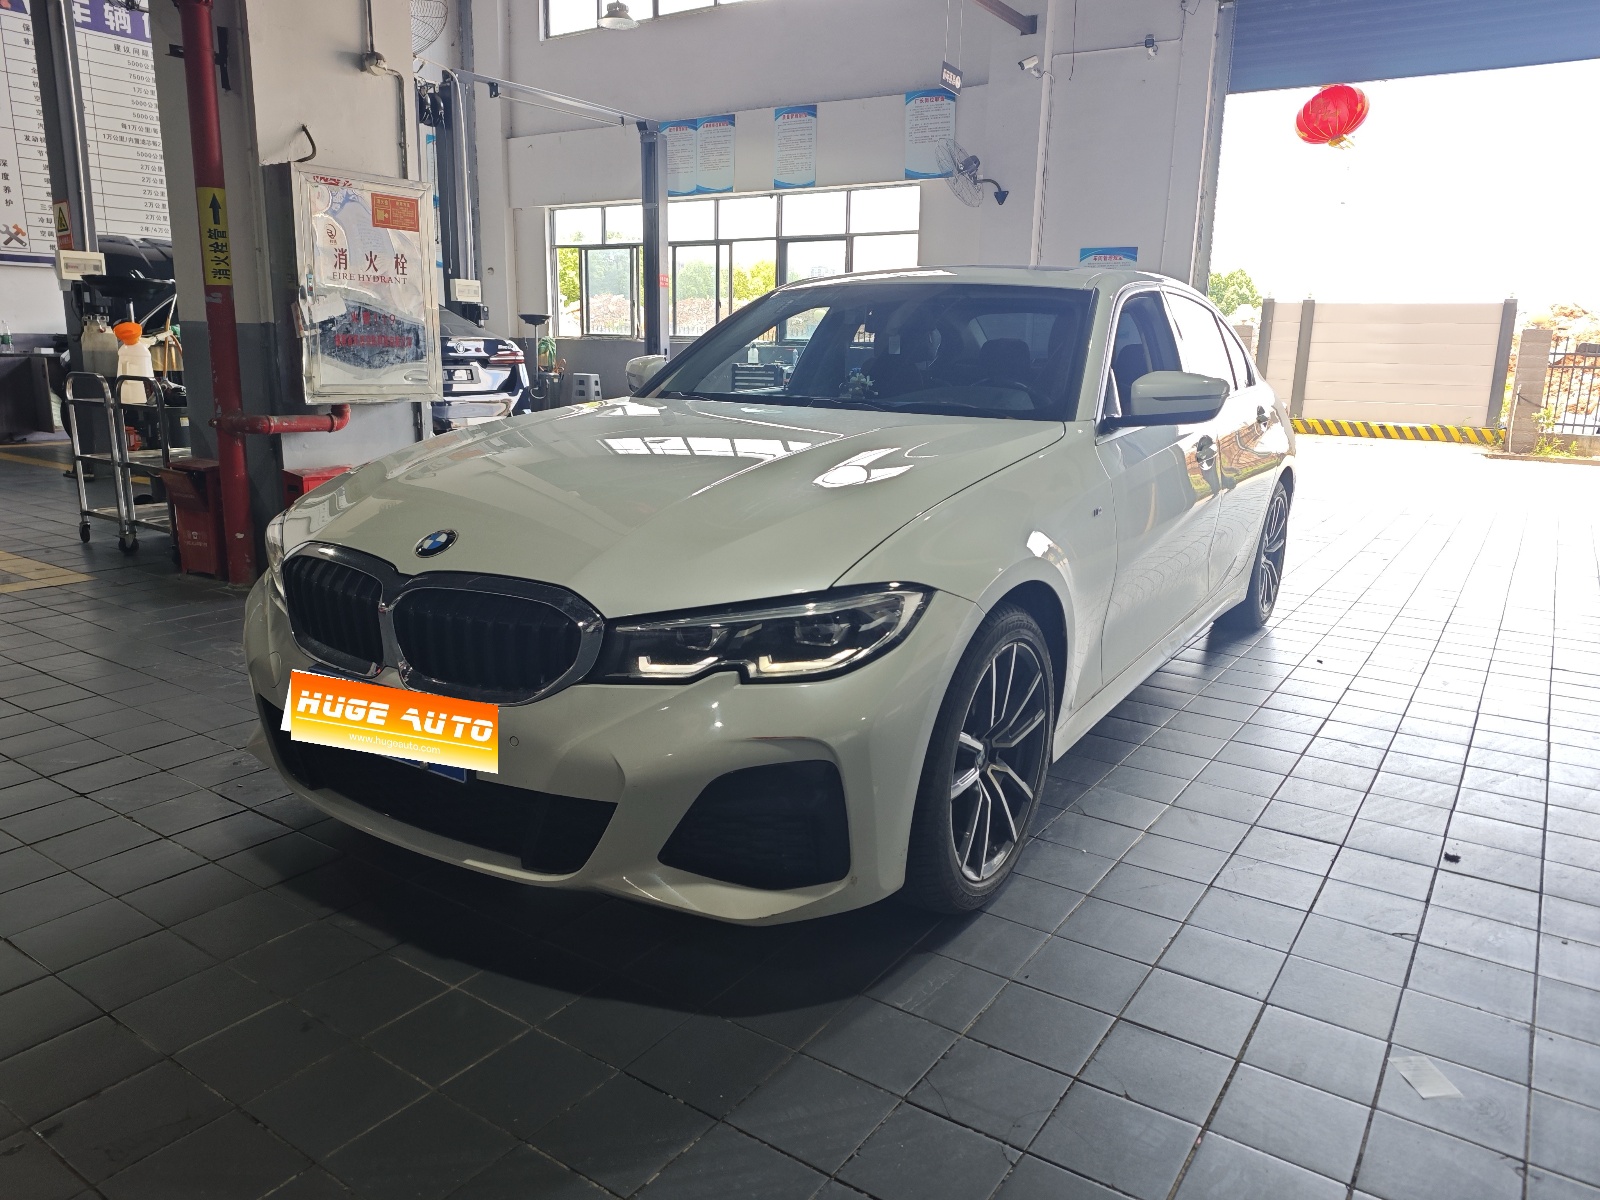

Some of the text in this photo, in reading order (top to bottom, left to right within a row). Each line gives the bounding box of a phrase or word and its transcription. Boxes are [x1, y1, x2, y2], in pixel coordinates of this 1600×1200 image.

[207, 228, 231, 280] 消火栓管
[333, 247, 408, 276] 消火栓
[332, 271, 408, 285] FIRE HYDRANT
